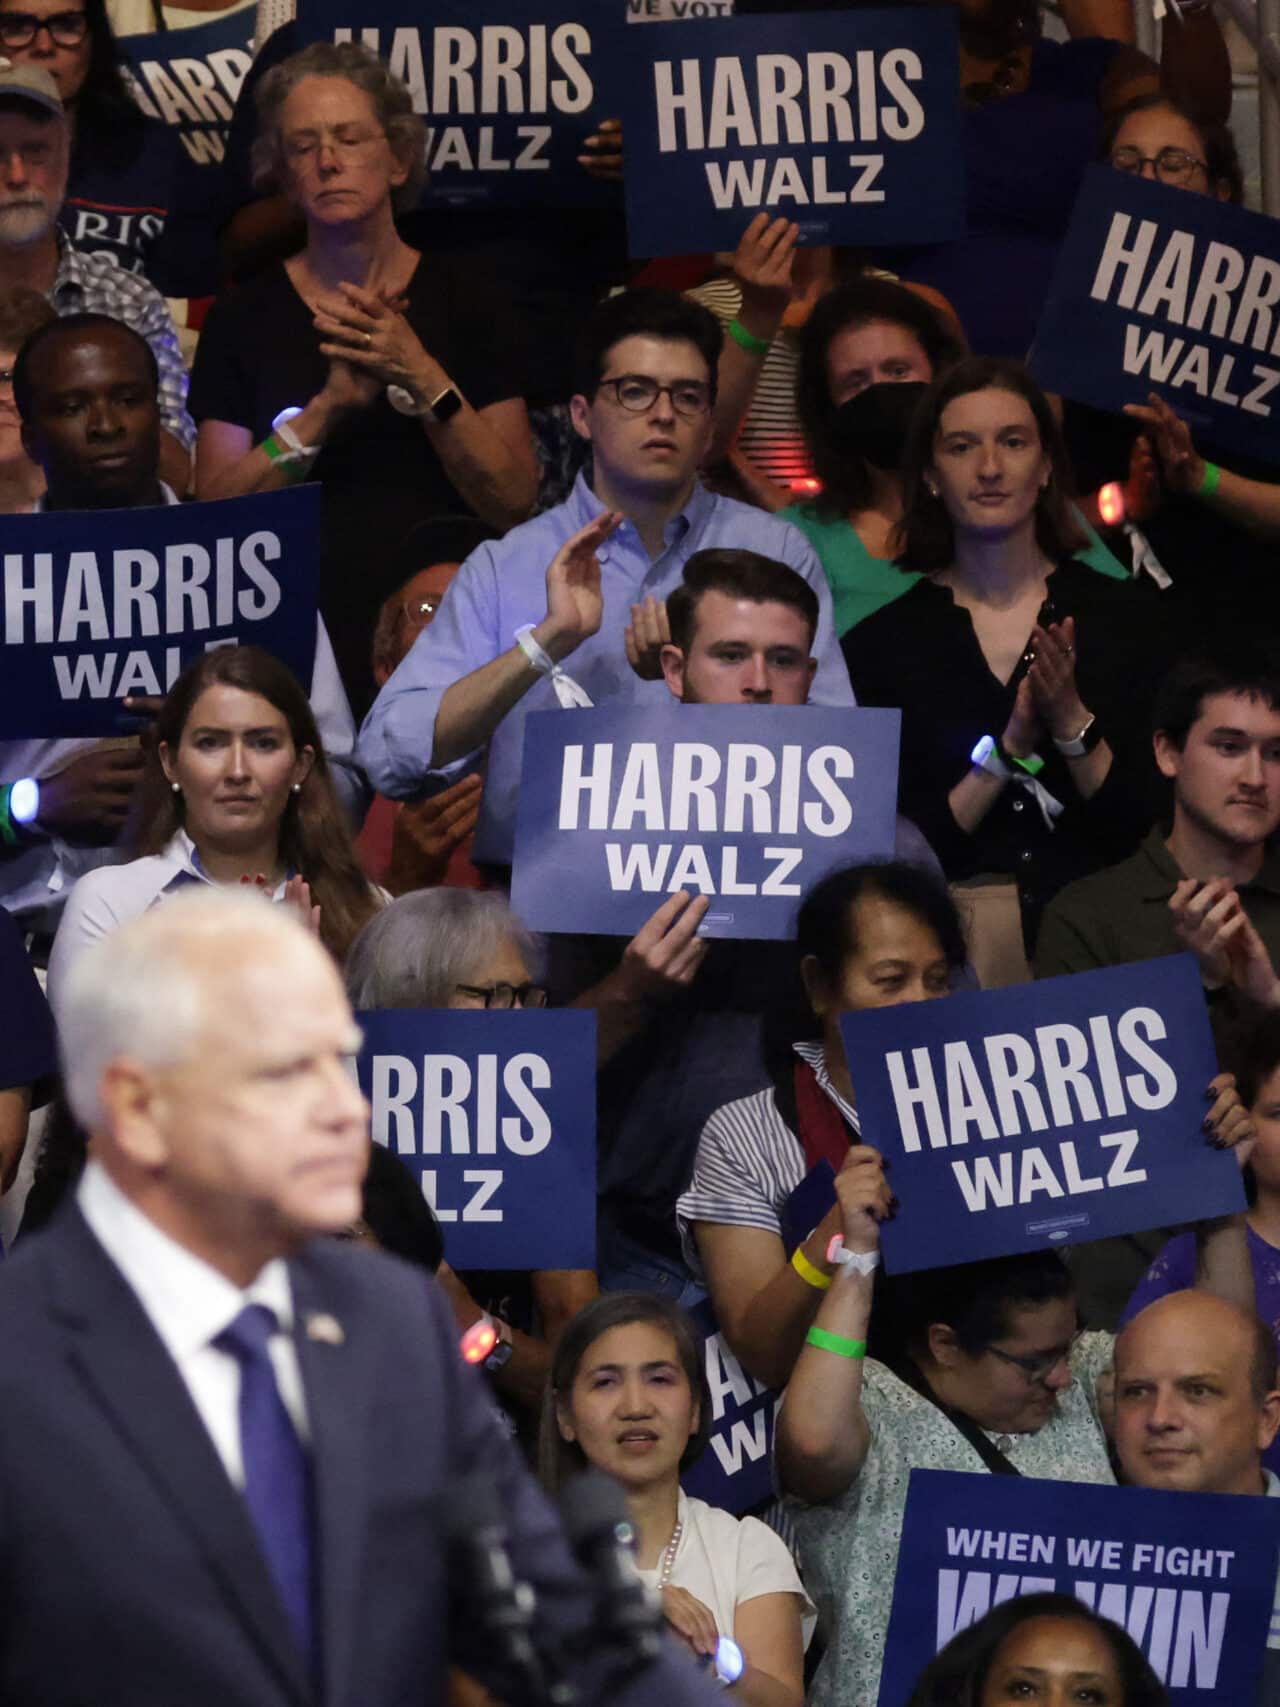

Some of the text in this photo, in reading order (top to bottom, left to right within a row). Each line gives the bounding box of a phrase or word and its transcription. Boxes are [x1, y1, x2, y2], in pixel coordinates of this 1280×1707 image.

[334, 22, 594, 115] ARRIS
[655, 48, 925, 153] HARRIS
[424, 125, 552, 171] ALZ
[705, 154, 885, 209] WALZ
[1090, 211, 1280, 357] HARR
[1123, 323, 1280, 417] WALZ
[4, 530, 282, 645] HARRIS
[558, 742, 854, 837] HARRIS
[605, 843, 803, 897] WALZ
[355, 1052, 552, 1156] RRIS
[885, 1006, 1178, 1153] HARRIS
[951, 1130, 1148, 1212] WALZ
[946, 1527, 1235, 1579] WHEN WE FIGHT
